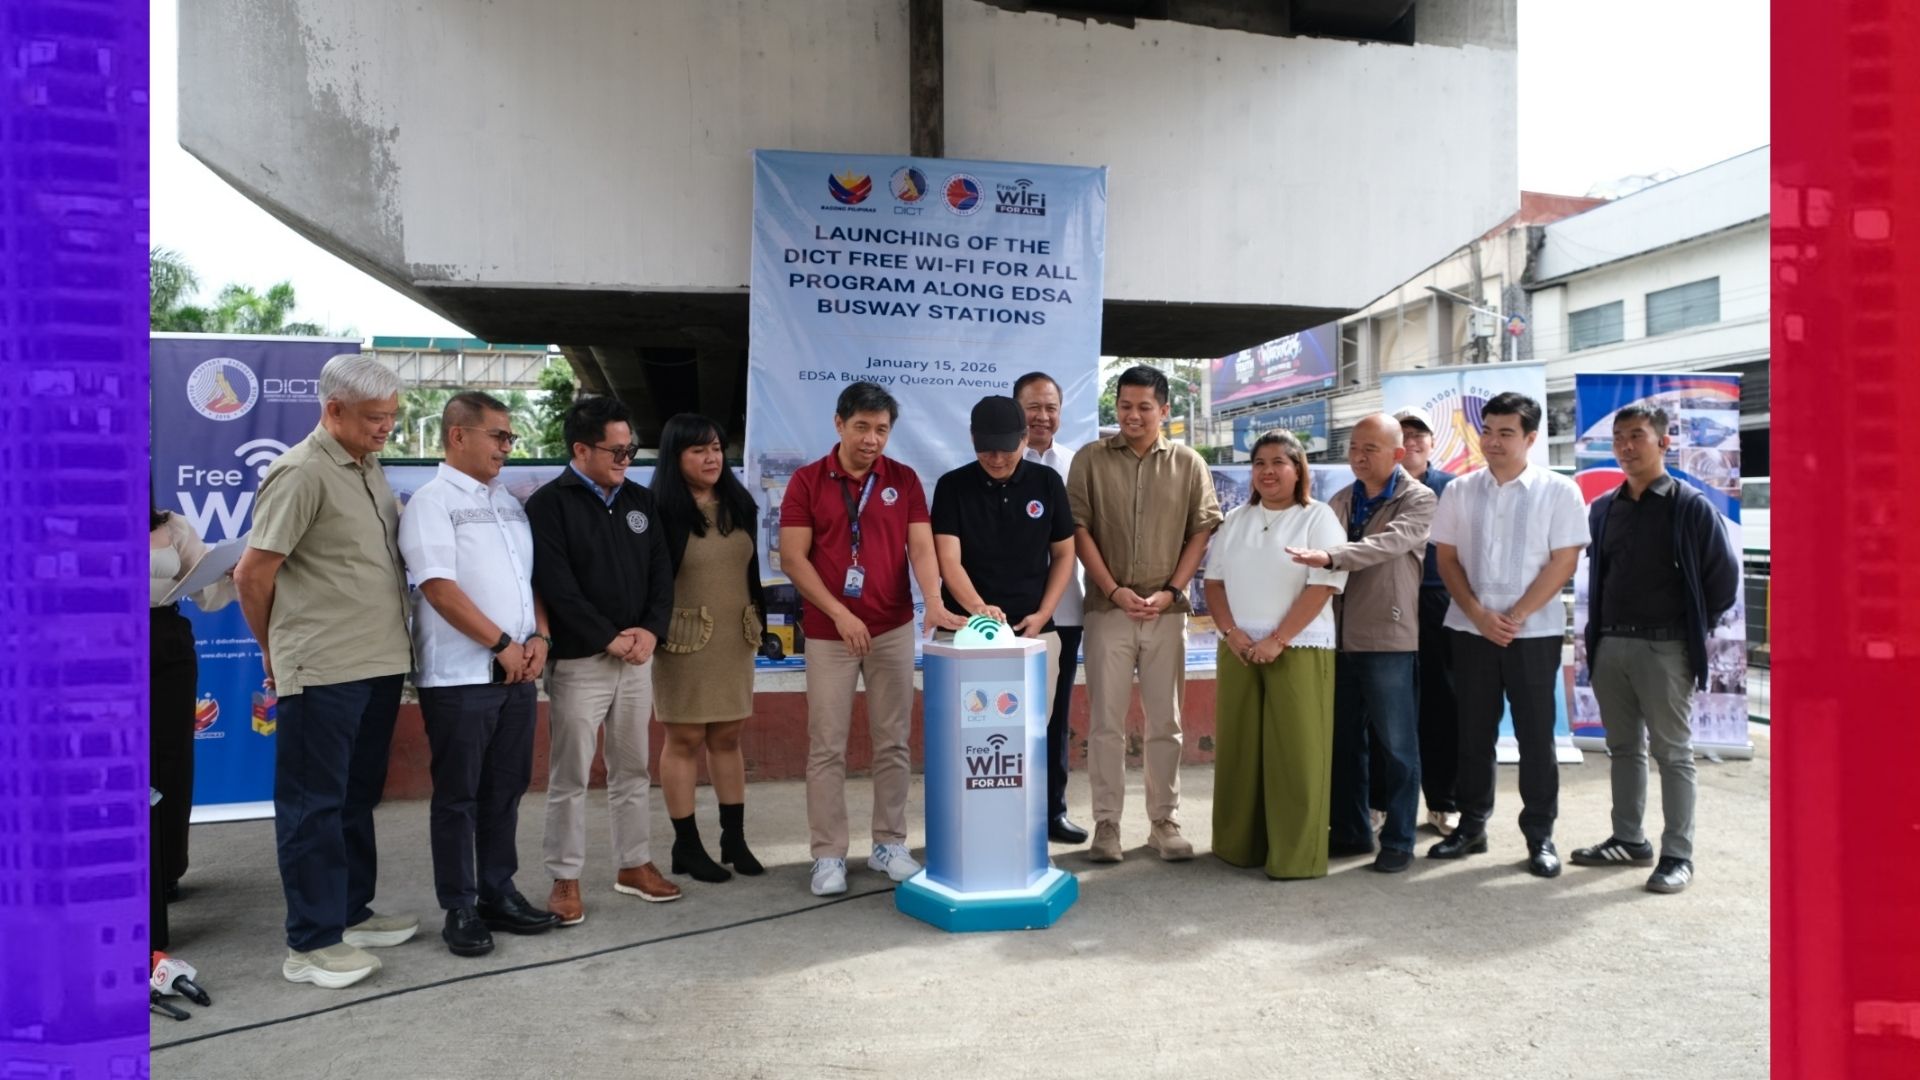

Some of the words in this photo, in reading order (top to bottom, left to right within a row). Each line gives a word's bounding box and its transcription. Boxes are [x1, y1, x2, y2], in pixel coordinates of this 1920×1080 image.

[996, 183, 1018, 192] Free
[996, 185, 1046, 208] WiFi
[893, 206, 924, 216] DICT
[1000, 205, 1021, 214] FOR
[1022, 207, 1041, 216] ALL
[815, 225, 960, 249] LAUNCHING
[967, 235, 999, 251] OF
[1004, 237, 1051, 256] THE
[784, 248, 842, 265] DICT
[848, 251, 908, 270] FREE
[915, 255, 975, 274] WI-FI
[982, 260, 1028, 277] FOR
[1035, 264, 1078, 281] ALL
[789, 273, 915, 294] PROGRAM
[922, 280, 1005, 300] ALONG
[1012, 285, 1073, 304] EDSA
[817, 298, 921, 317] BUSWAY
[928, 304, 1047, 326] STATIONS
[865, 356, 929, 372] January
[935, 360, 956, 373] 15,
[960, 361, 998, 373] 2026
[263, 378, 320, 394] DICT
[799, 370, 837, 381] EDSA
[840, 371, 896, 385] Busway
[899, 374, 955, 387] Quezon
[957, 376, 1010, 389] Avenue
[178, 464, 243, 487] Free
[966, 745, 990, 755] Free
[966, 745, 1023, 776] WiFi
[972, 778, 995, 788] FOR
[996, 777, 1018, 788] ALL
